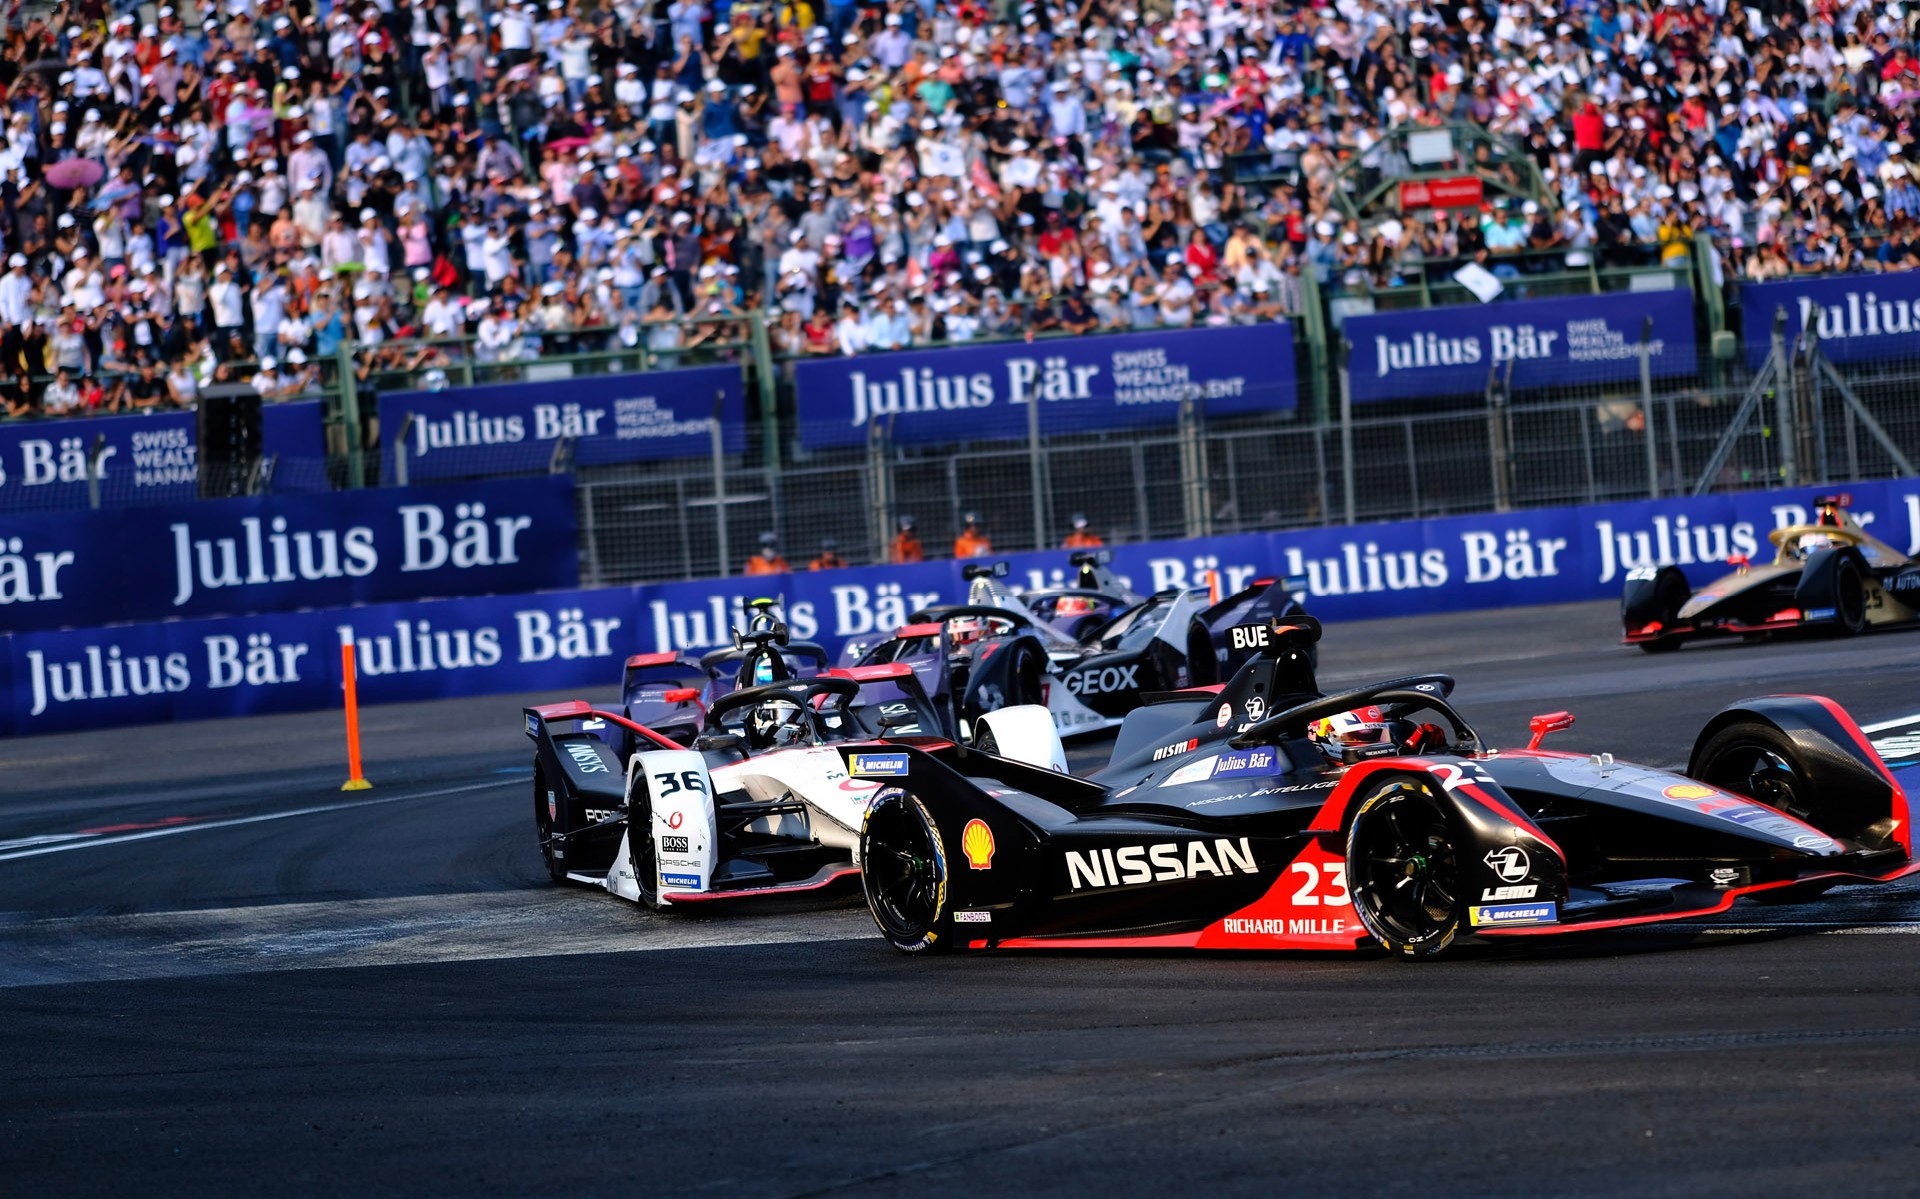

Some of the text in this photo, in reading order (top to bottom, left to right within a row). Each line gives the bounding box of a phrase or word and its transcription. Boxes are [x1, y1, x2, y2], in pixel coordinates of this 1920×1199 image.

[1567, 319, 1606, 334] SWISS
[1112, 348, 1167, 371] SWISS
[1376, 324, 1559, 378] Julius Bär
[1113, 365, 1188, 387] WEALTH
[850, 356, 1099, 427] Julius Bär
[615, 397, 657, 414] SWISS
[131, 428, 189, 452] SWISS
[415, 403, 605, 457] Julius Bär
[19, 437, 117, 487] Bär
[132, 446, 197, 469] WEALT
[170, 502, 532, 606] Julius Bär
[1595, 512, 1758, 583] Julius
[1284, 528, 1567, 604] Julius Bär
[832, 583, 940, 637] Bär
[514, 608, 622, 664] Bär
[1233, 625, 1269, 649] BUE
[27, 633, 309, 717] Julius Bär
[1063, 664, 1140, 696] GEOX
[866, 761, 903, 770] MICHELIN
[1213, 758, 1247, 776] Julius
[1248, 753, 1272, 769] Bär
[655, 771, 707, 798] 36
[663, 837, 688, 848] BOSS
[1065, 837, 1259, 889] NISSAN
[667, 877, 698, 885] MICHELIN
[1291, 861, 1353, 907] 23
[1481, 885, 1539, 901] LEMO
[1224, 918, 1345, 934] RICHARD MILLE
[1493, 908, 1550, 919] MICHELIN
